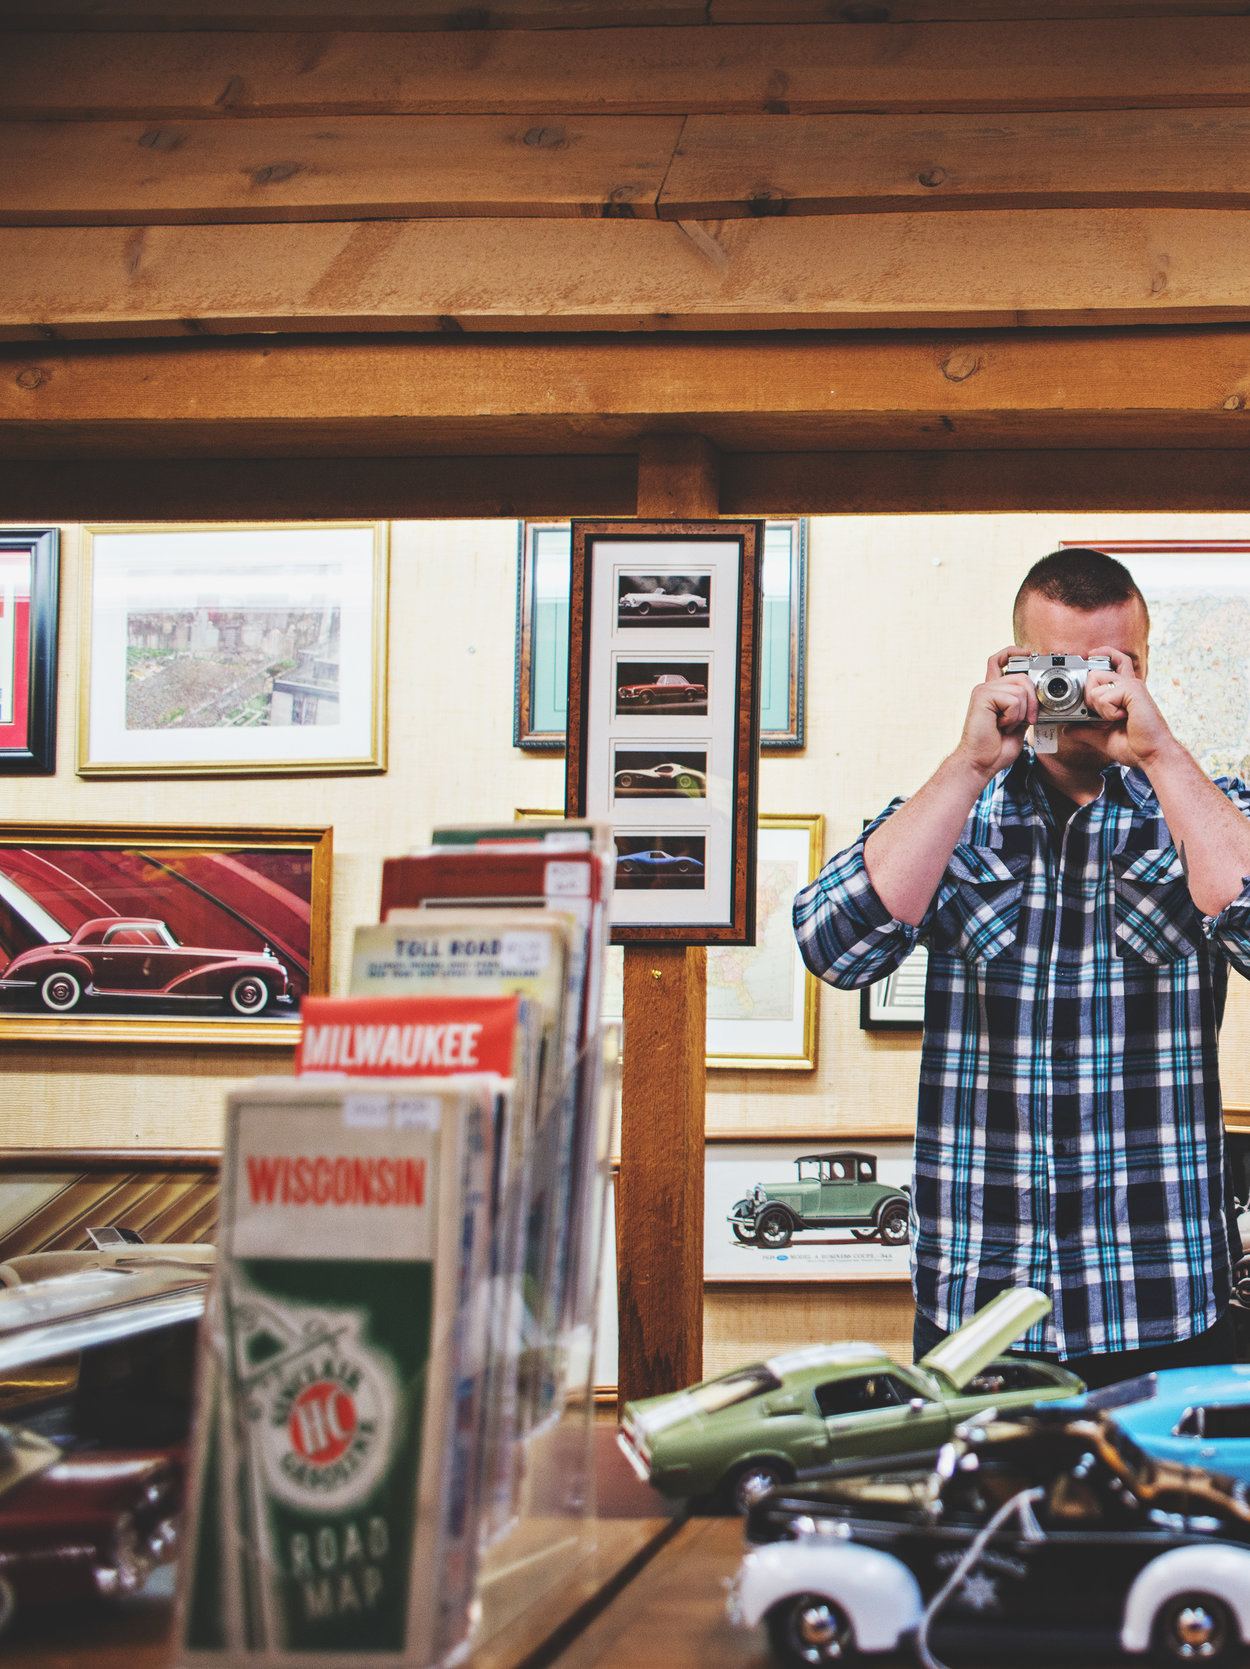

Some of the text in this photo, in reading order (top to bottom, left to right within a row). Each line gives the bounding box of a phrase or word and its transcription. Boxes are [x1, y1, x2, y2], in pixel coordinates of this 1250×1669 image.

[396, 939, 438, 956] TOLL
[449, 939, 501, 956] ROAD
[302, 1023, 482, 1067] MILWAUKEE
[246, 1156, 426, 1206] WISCONSIN
[291, 1517, 388, 1577] ROAD
[305, 1566, 382, 1619] MAP
